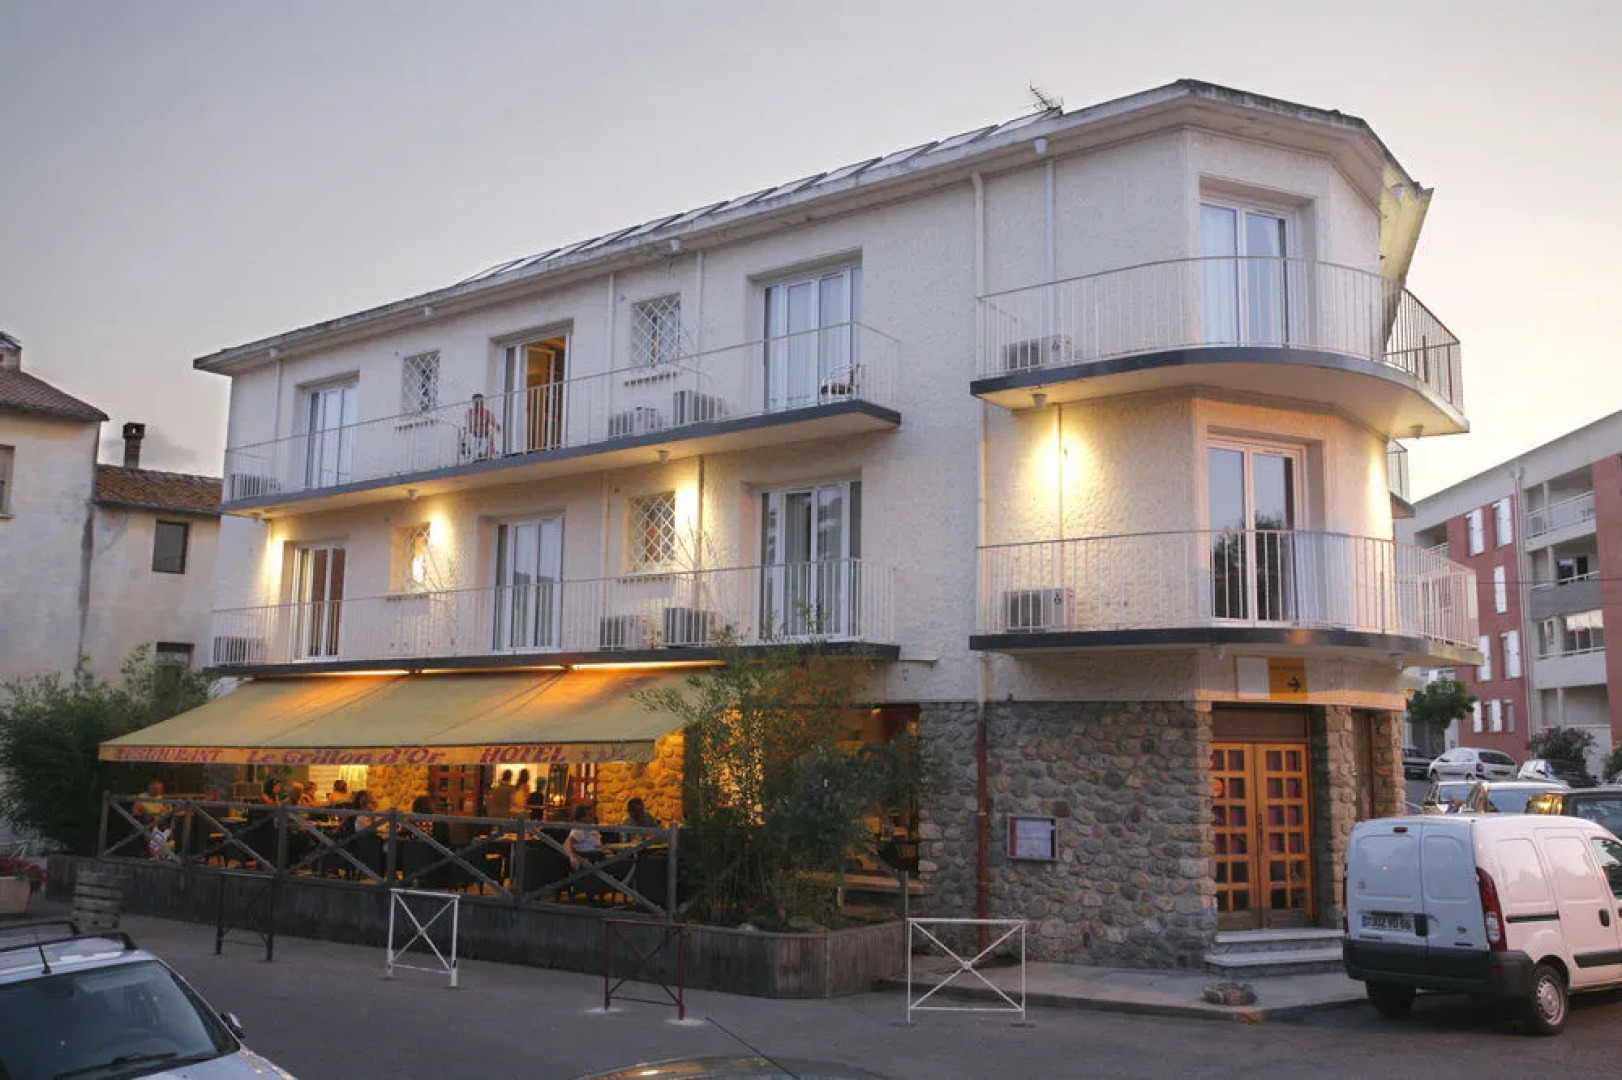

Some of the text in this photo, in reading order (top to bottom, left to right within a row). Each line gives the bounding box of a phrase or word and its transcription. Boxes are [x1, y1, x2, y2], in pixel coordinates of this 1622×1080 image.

[246, 749, 276, 763] Le
[282, 750, 373, 764] Grillon
[479, 746, 567, 763] HOTEL
